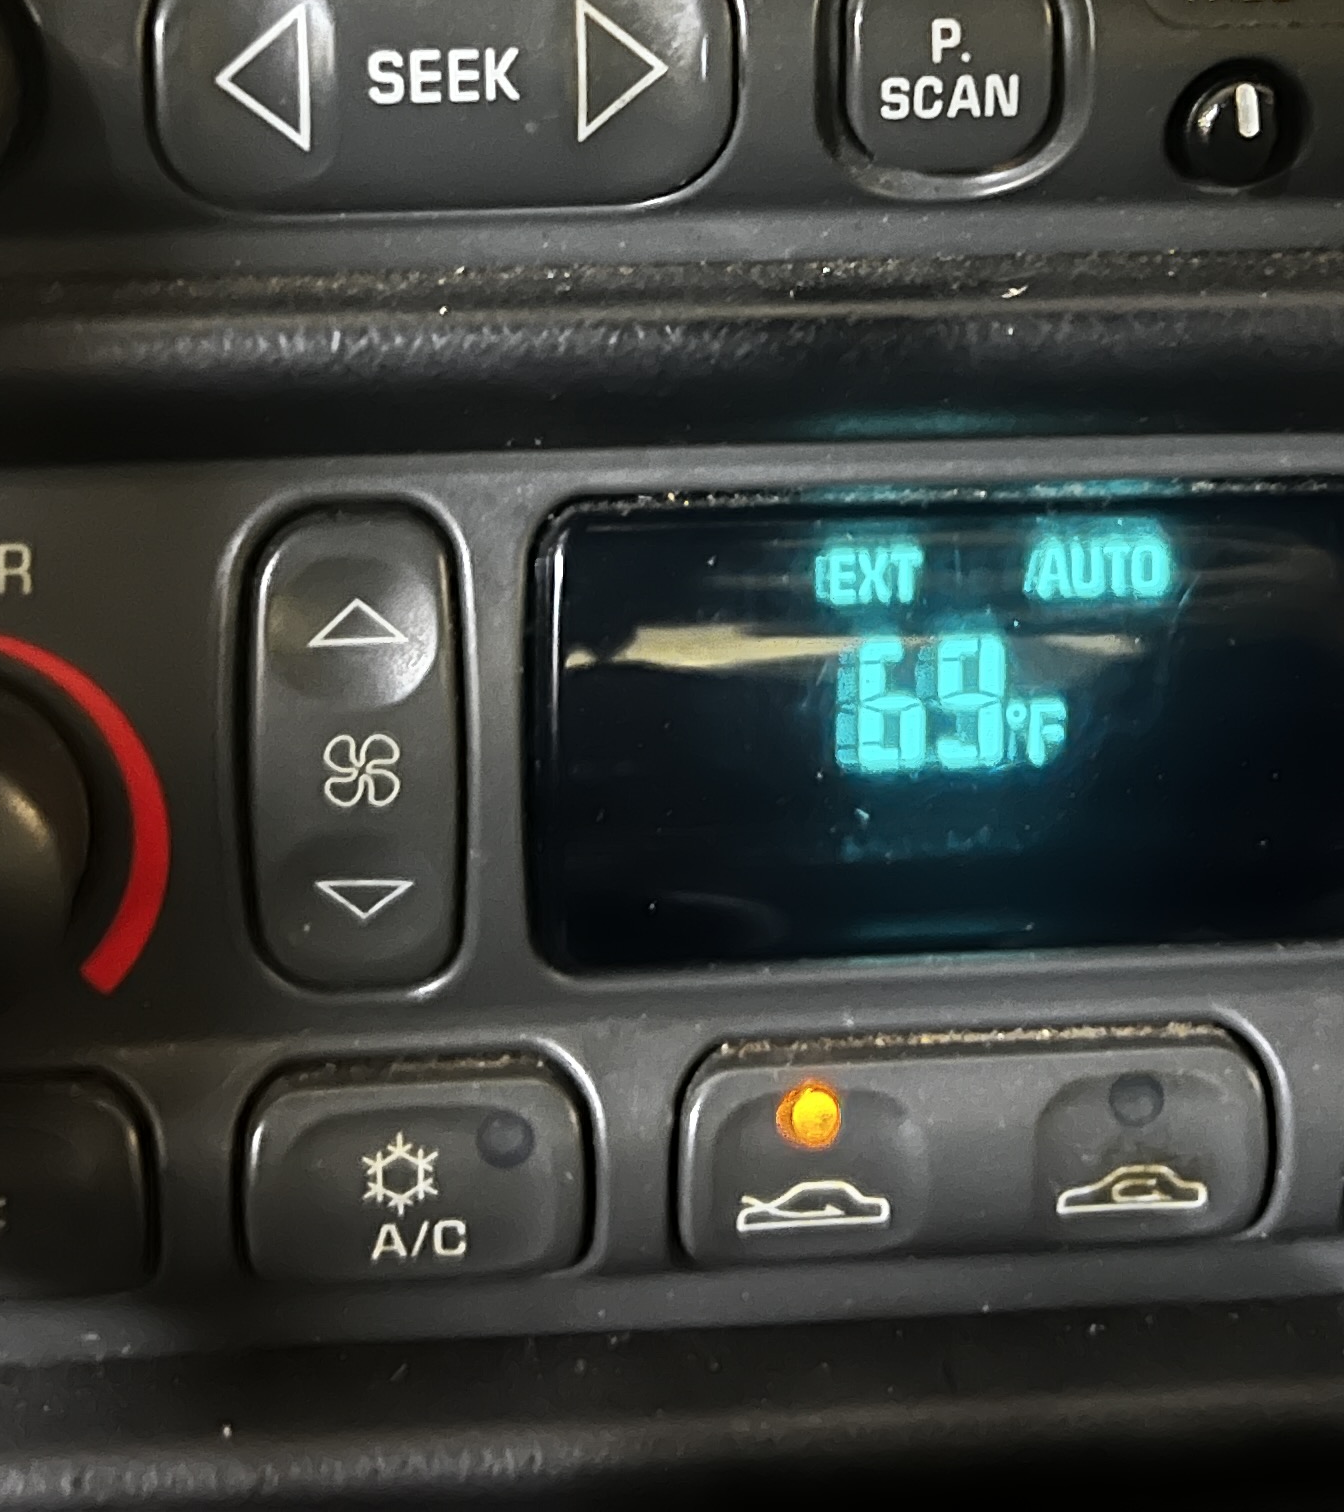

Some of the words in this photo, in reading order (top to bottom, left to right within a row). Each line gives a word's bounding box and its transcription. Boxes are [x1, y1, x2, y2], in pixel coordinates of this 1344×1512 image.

[931, 17, 972, 64] P.
[366, 48, 522, 104] SEEK
[879, 73, 1021, 121] SCAN
[822, 542, 923, 604] EXT
[1032, 537, 1170, 599] AUTO
[370, 1220, 468, 1262] A/C
